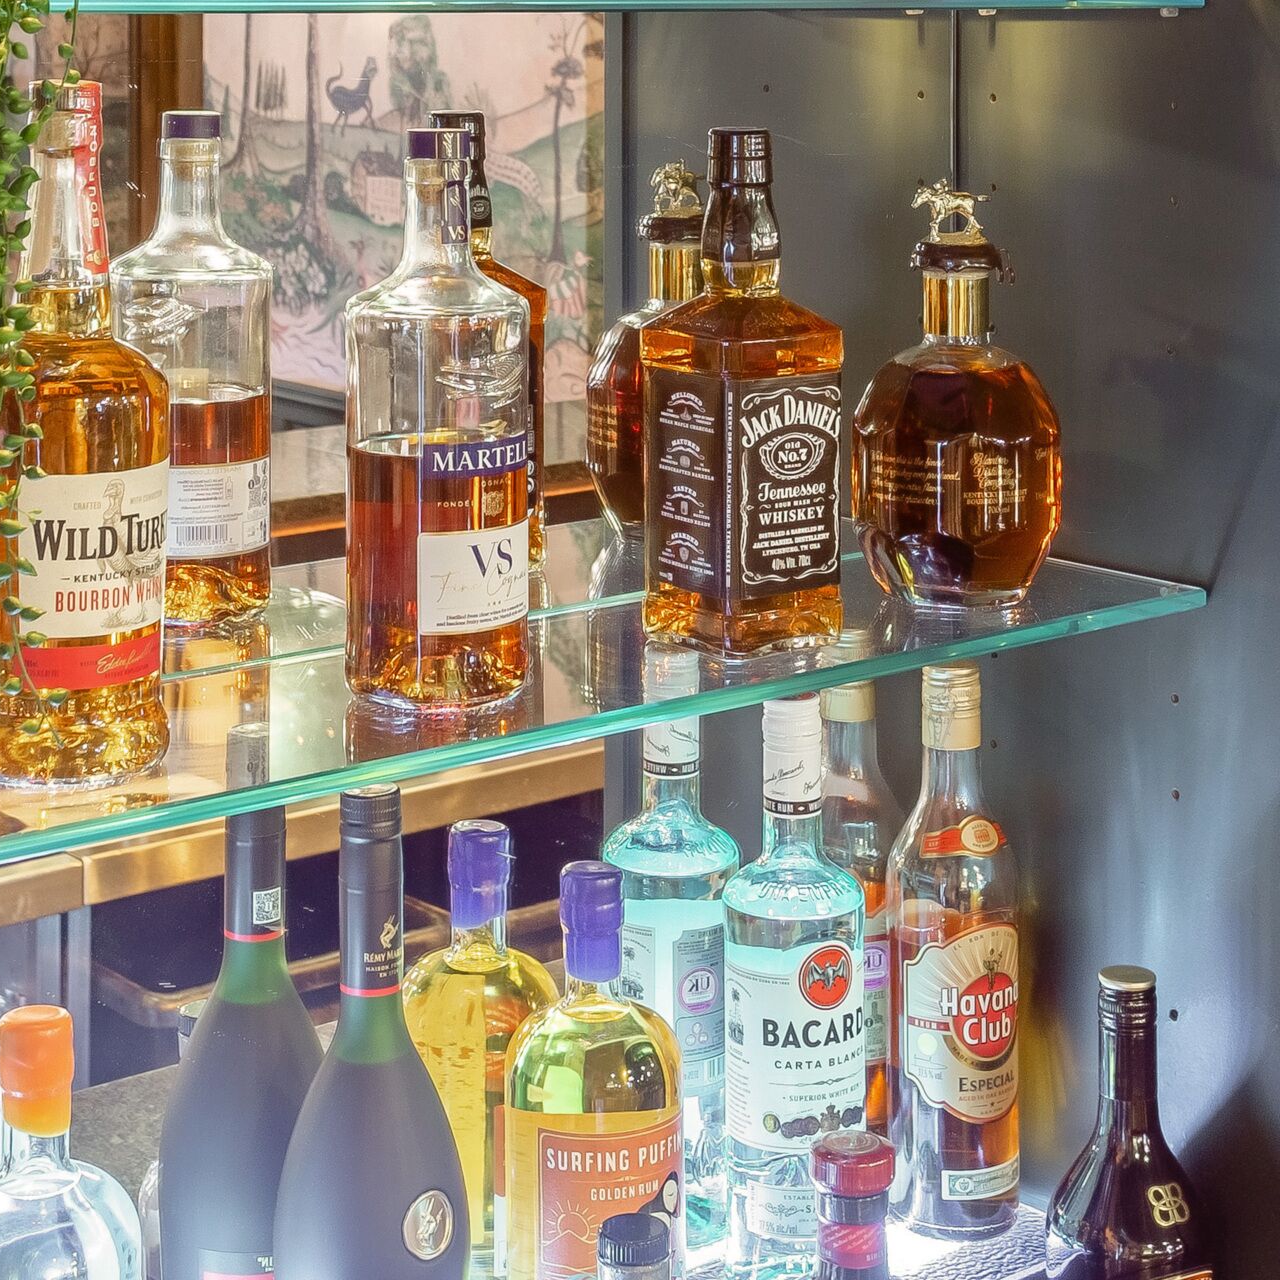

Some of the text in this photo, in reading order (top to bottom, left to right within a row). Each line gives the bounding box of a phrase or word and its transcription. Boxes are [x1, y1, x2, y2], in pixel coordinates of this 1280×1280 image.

[89, 125, 100, 228] BOURBON
[448, 225, 466, 241] VS
[740, 394, 841, 448] JACK DANIEL'S
[784, 441, 801, 450] Old
[432, 440, 528, 472] MARTELL
[777, 448, 808, 464] No.7
[757, 482, 826, 502] Tennessee
[73, 501, 102, 511] CRAFTED
[774, 499, 811, 509] SOUR MASH
[759, 505, 825, 526] WHISKEY
[32, 519, 118, 562] WILD
[753, 532, 830, 549] JACK DANIEL DISTILLERY
[758, 530, 785, 539] DISTILLED
[468, 538, 513, 579] VS
[771, 557, 786, 571] 40%
[74, 570, 132, 583] KENTUCKY
[55, 586, 131, 613] BOURBON
[778, 802, 795, 813] RUM
[363, 951, 386, 963] RÉMY
[365, 964, 389, 972] MAISON
[939, 980, 1019, 1017] Havana
[962, 1010, 1012, 1047] Club
[774, 1060, 822, 1070] CARTA
[958, 1070, 1015, 1093] ESPECIAL
[789, 1093, 827, 1102] SUPERIOR
[829, 1088, 849, 1098] WHITE
[958, 1094, 977, 1102] AGED
[986, 1091, 998, 1100] OAK
[545, 1130, 683, 1172] SURFING PUFFIN
[590, 1180, 660, 1201] GOLDEN RUM
